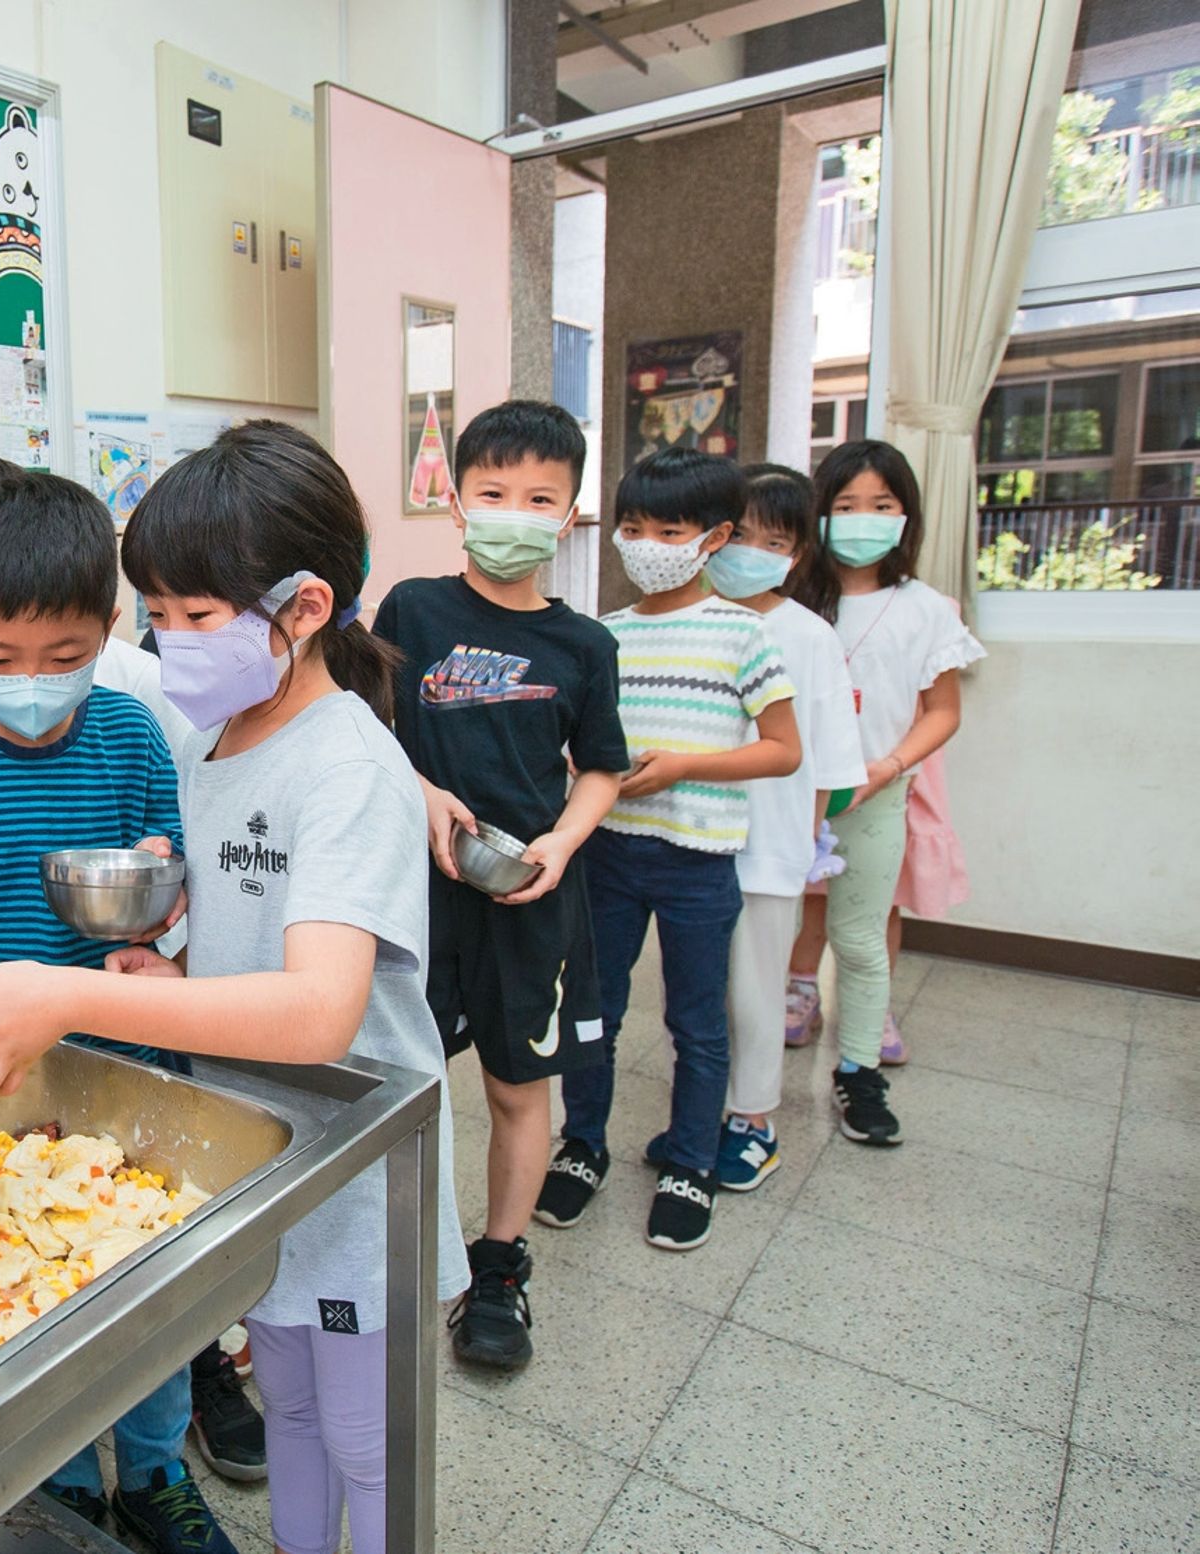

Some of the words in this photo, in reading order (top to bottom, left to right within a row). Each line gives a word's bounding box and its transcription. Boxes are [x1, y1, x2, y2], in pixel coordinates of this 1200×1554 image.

[435, 644, 532, 686] NIKE
[218, 840, 254, 873] Harry
[252, 842, 289, 877] Potter
[739, 1140, 769, 1169] N
[657, 1176, 710, 1208] didas
